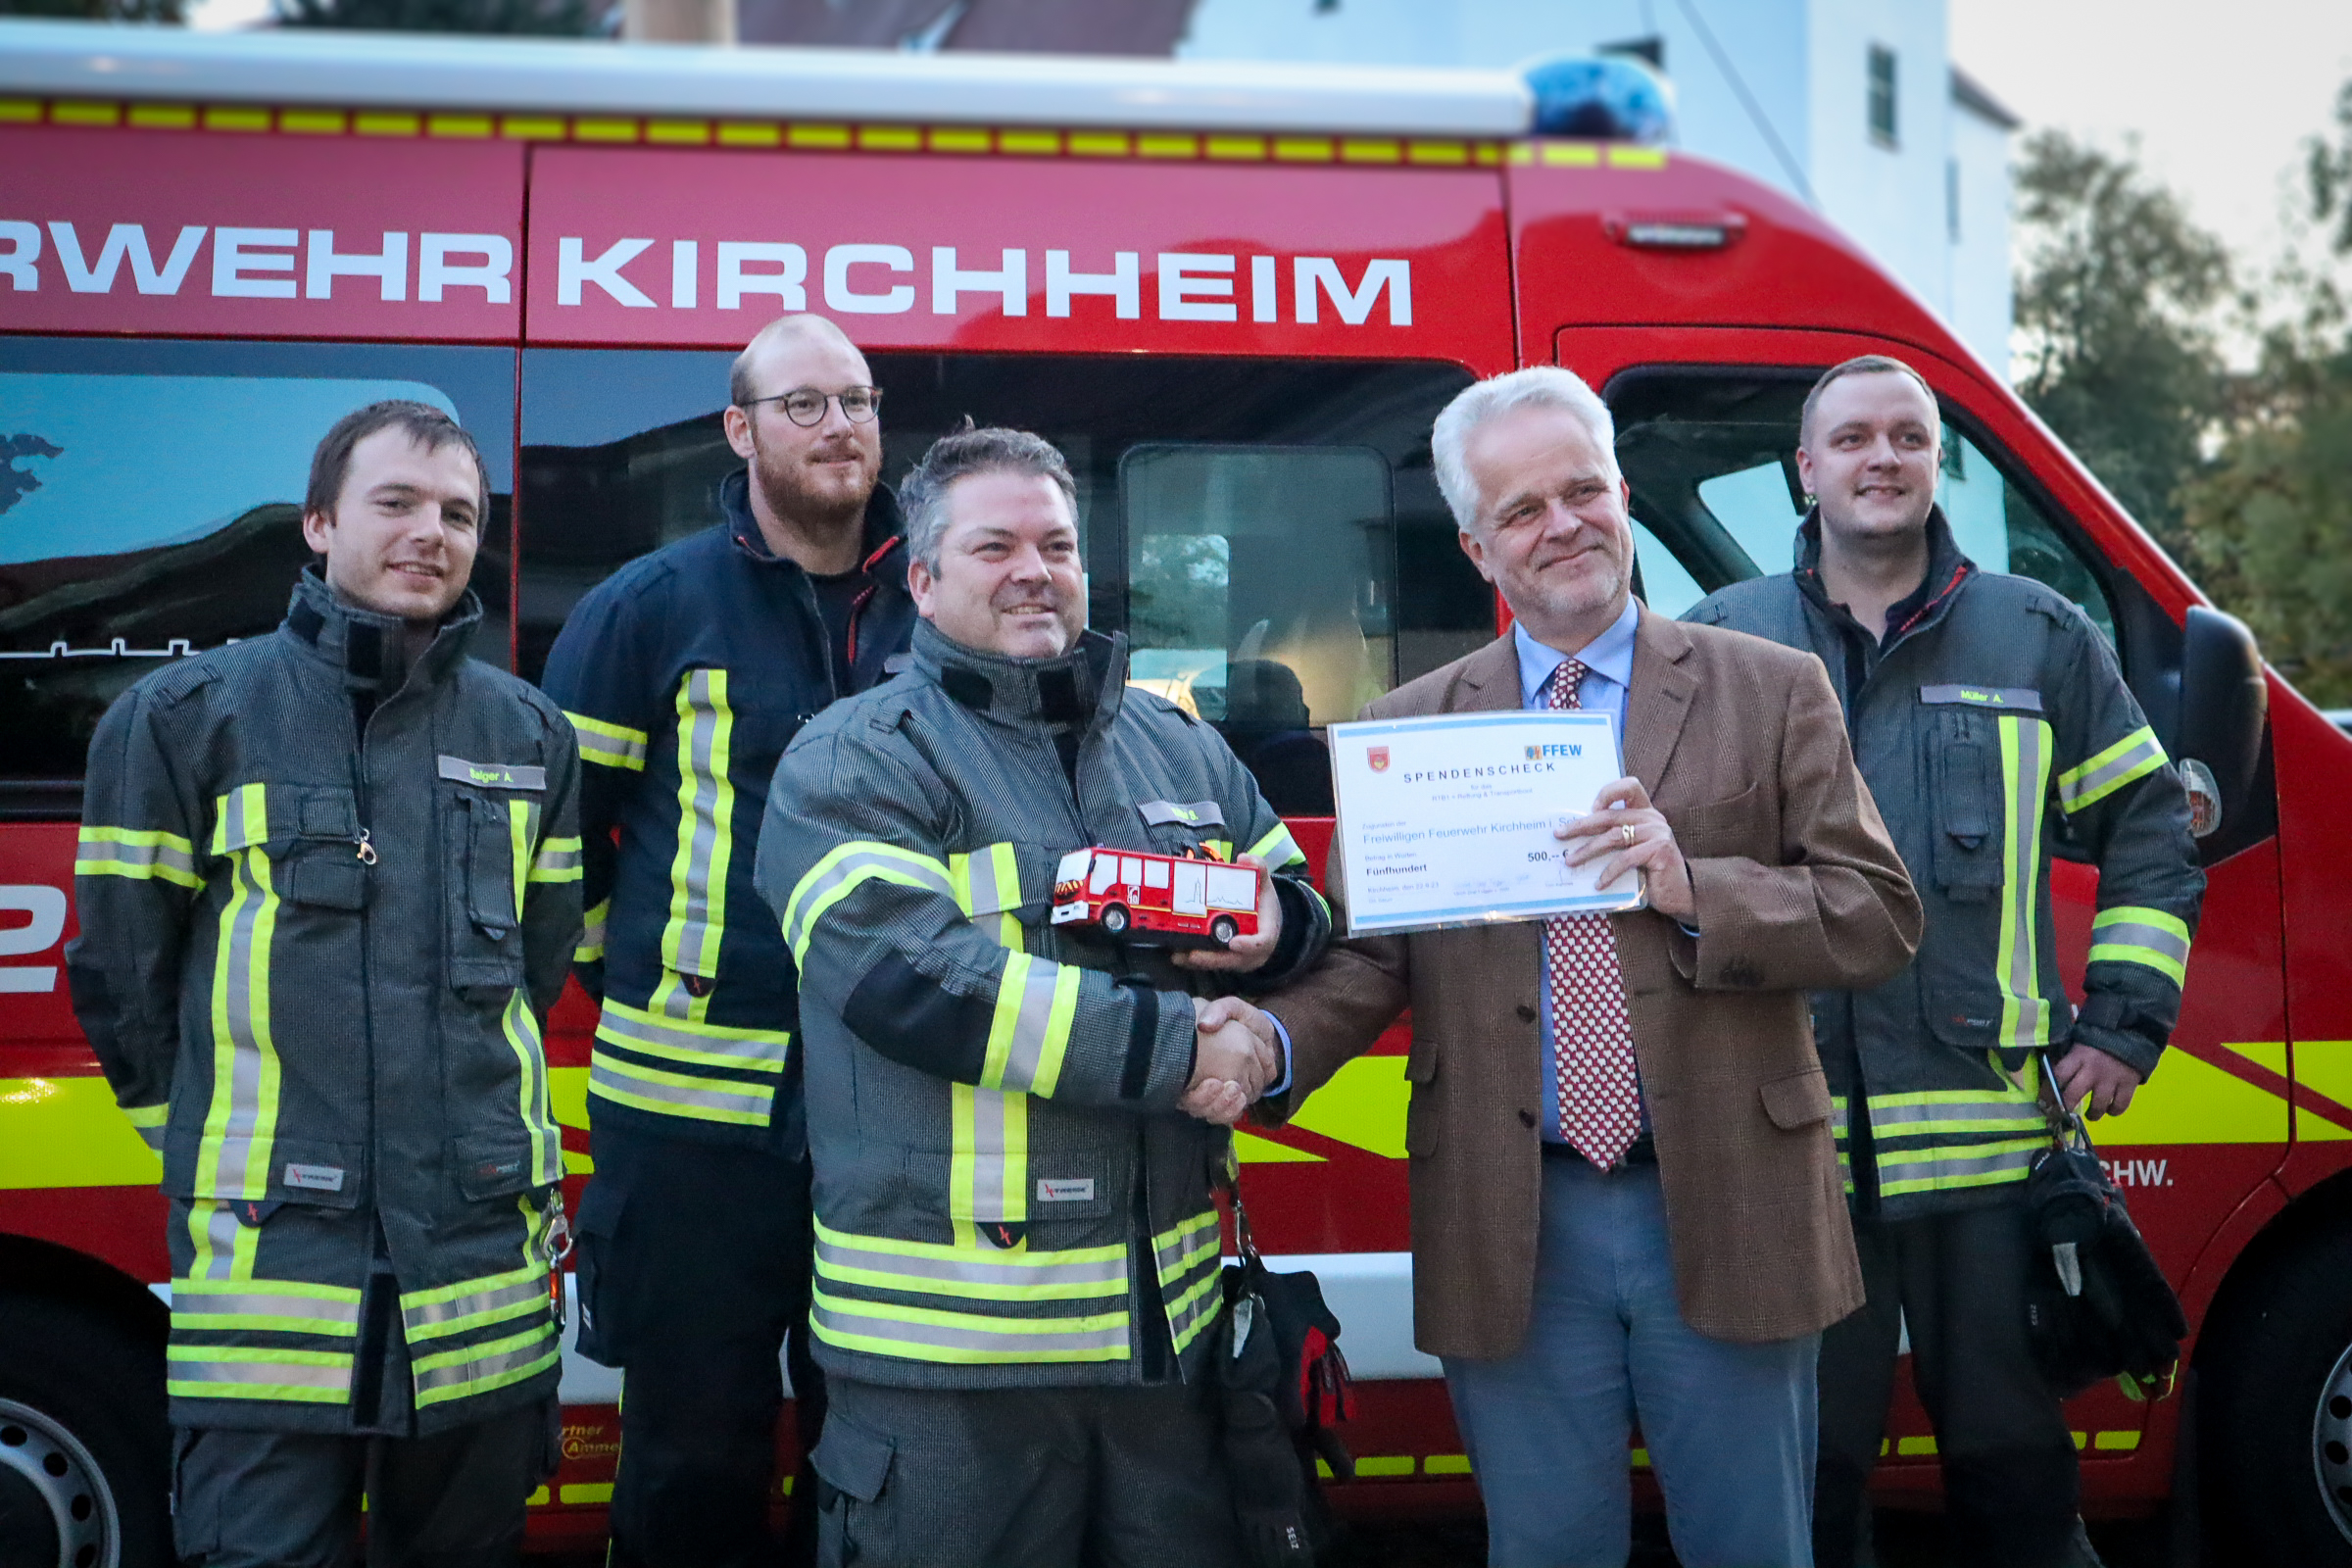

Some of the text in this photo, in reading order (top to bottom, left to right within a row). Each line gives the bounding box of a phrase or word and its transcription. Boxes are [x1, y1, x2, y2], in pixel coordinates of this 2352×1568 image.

[557, 235, 1413, 327] KIRCHHEIM
[1542, 744, 1583, 757] FFEW
[1403, 762, 1555, 784] SPENDENSCHECK
[1363, 831, 1426, 844] Freiwilligen
[1428, 824, 1488, 839] Feuerwehr
[1491, 819, 1546, 834] Kirchheim
[1366, 863, 1428, 877] Fünfhundert
